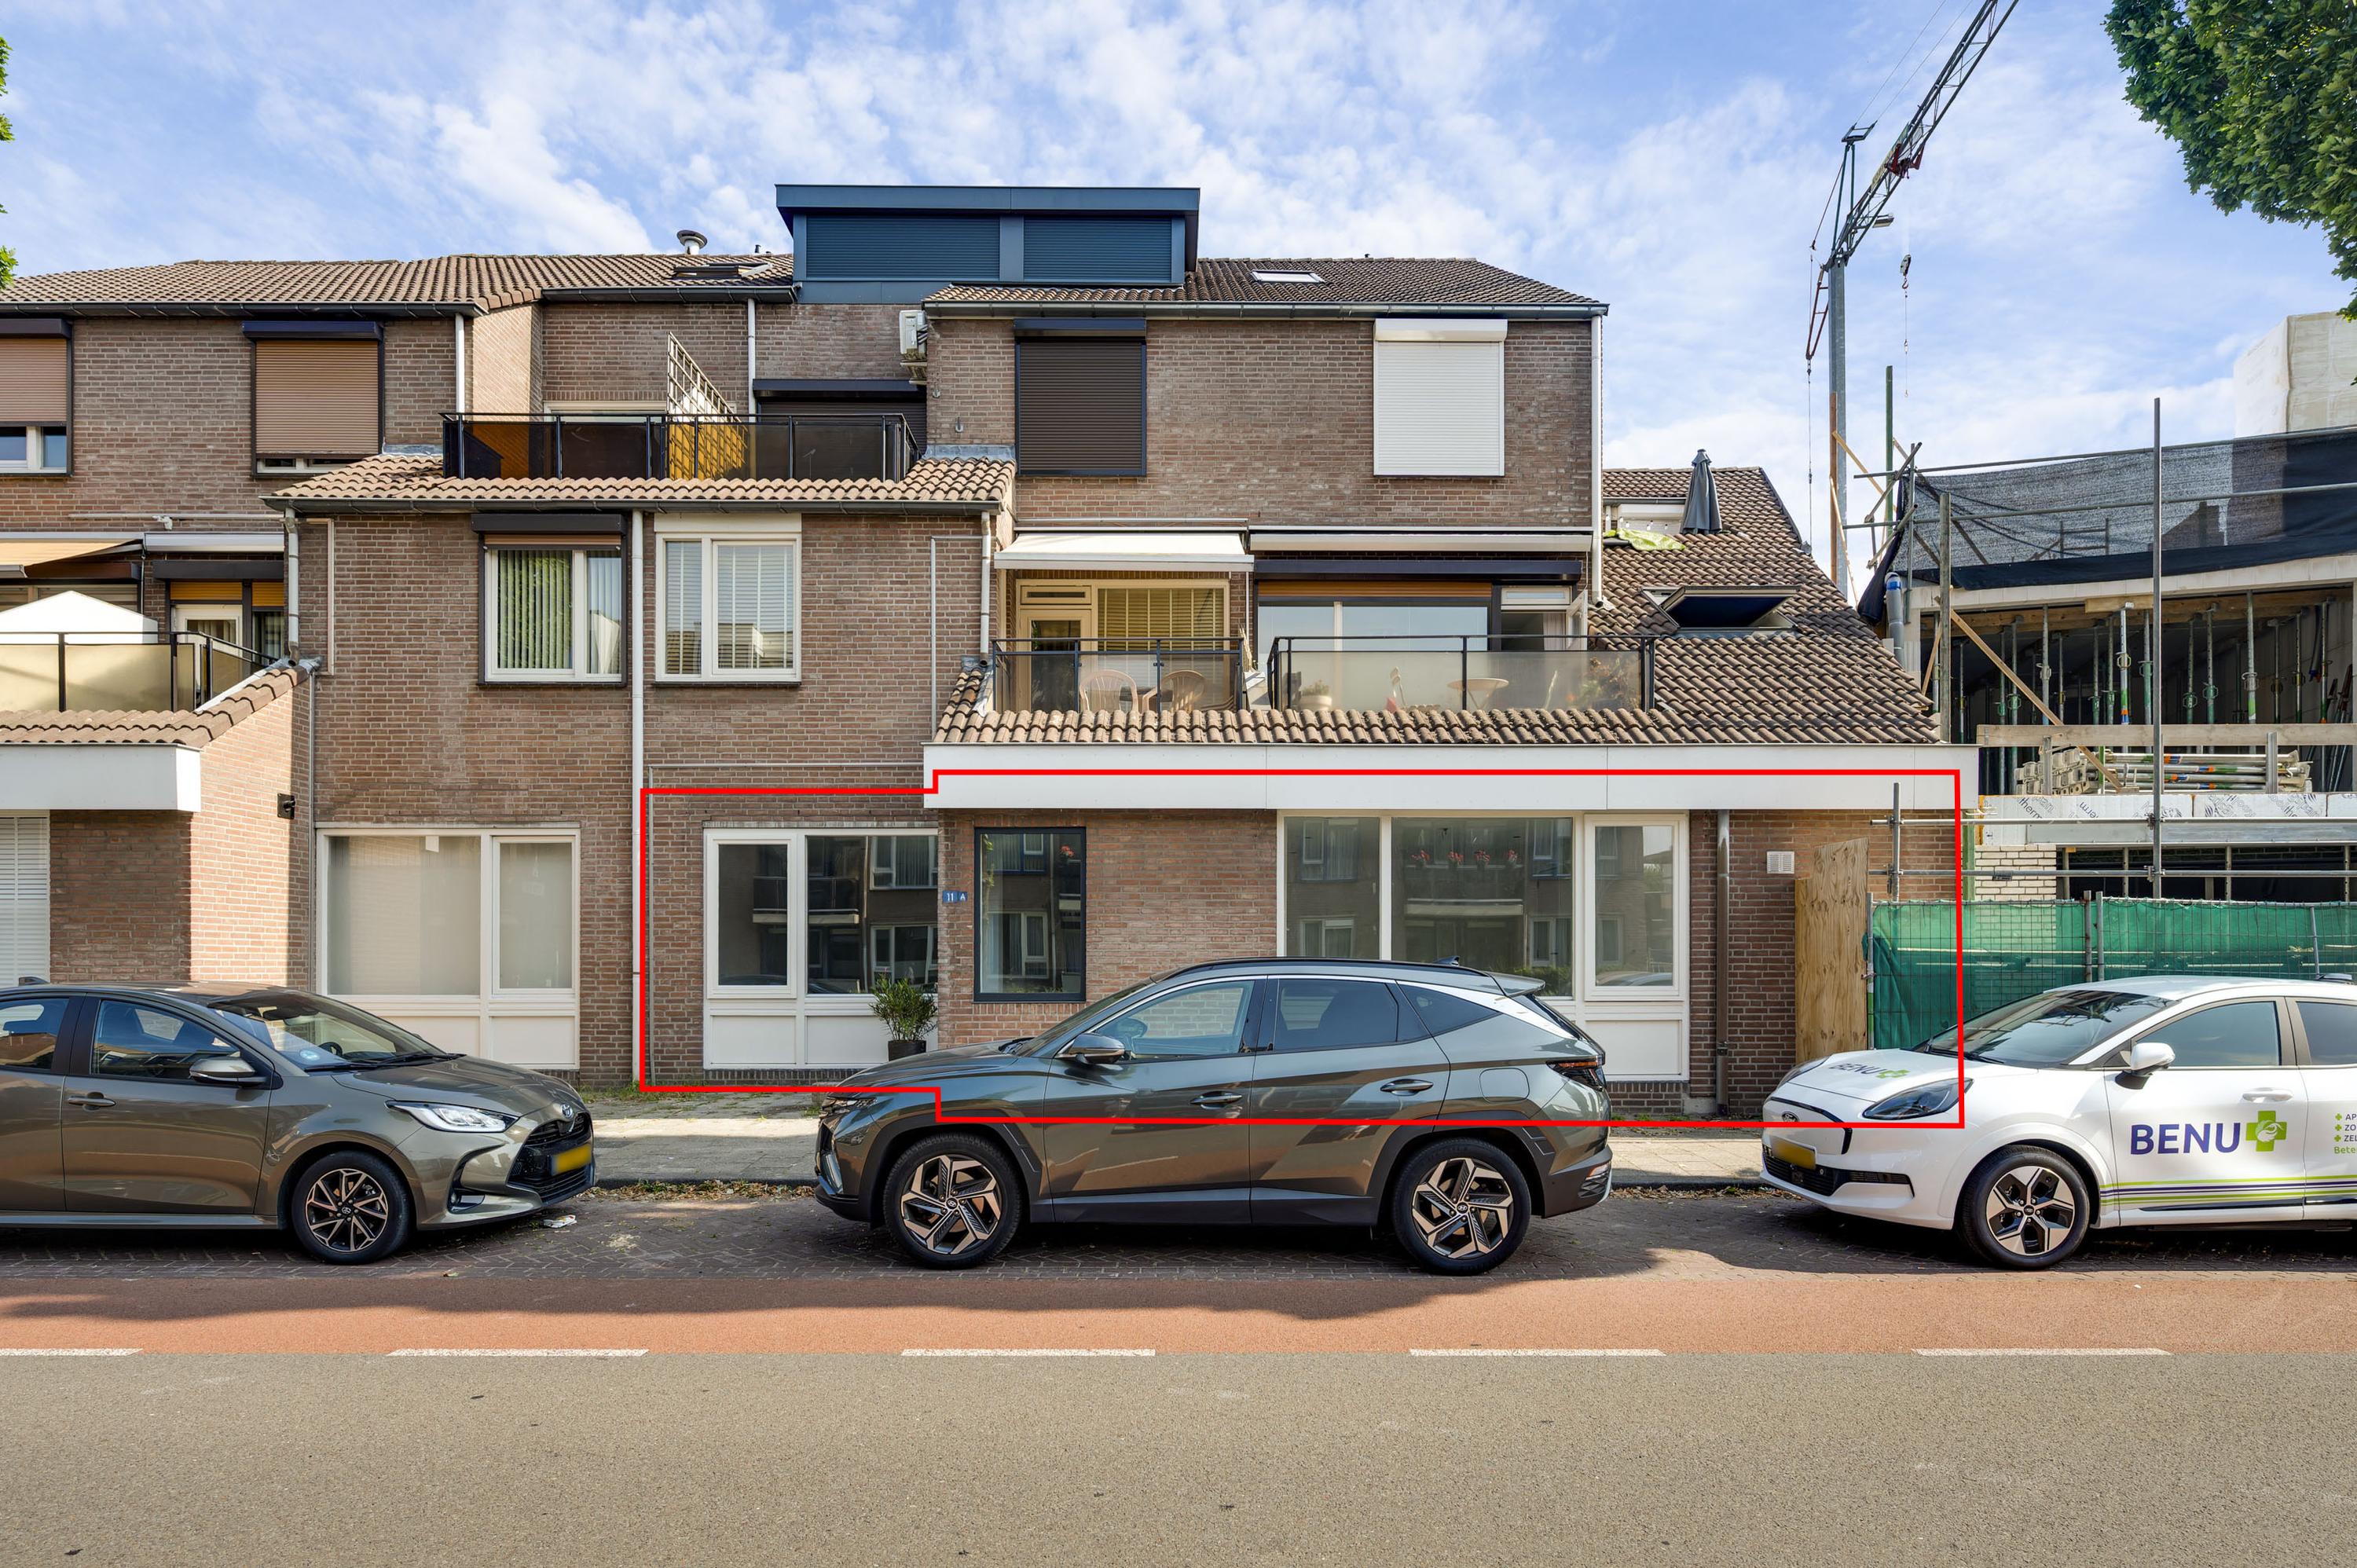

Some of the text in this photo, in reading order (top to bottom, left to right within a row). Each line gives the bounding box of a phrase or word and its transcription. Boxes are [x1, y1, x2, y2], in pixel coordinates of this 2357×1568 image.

[947, 892, 966, 902] 11 A
[1828, 1064, 1887, 1074] BENU
[2130, 1123, 2241, 1155] BENU
